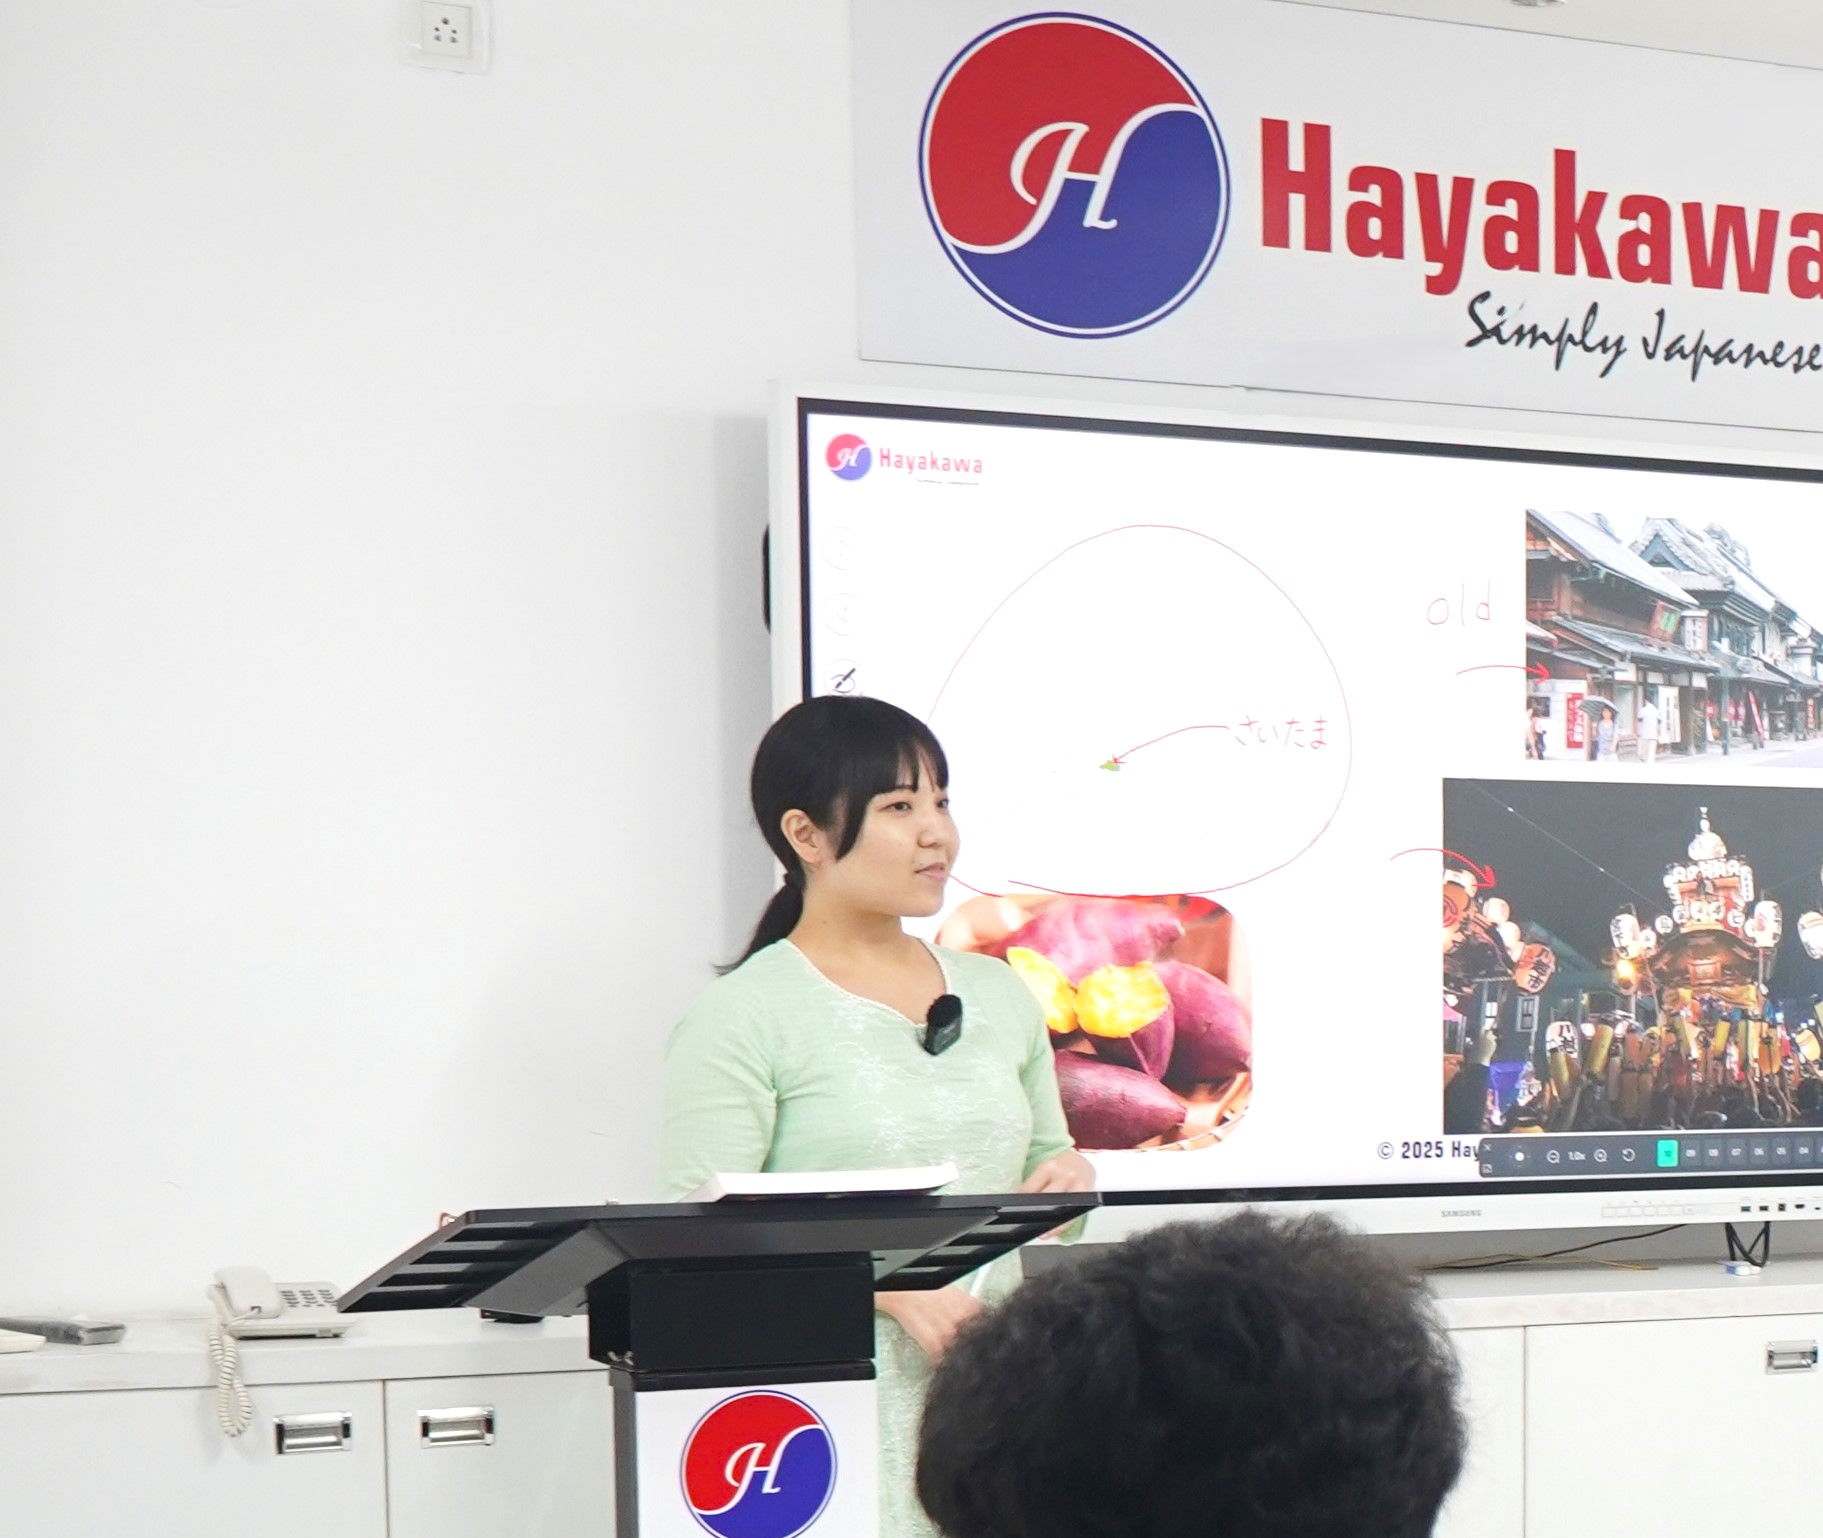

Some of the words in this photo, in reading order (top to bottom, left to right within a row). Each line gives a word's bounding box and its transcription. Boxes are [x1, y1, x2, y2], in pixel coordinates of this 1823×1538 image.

[1465, 290, 1626, 376] Simply
[879, 448, 983, 474] Hayakawa
[1427, 580, 1492, 626] old
[1235, 714, 1329, 750] さいたま
[1402, 1141, 1444, 1159] 2025
[1441, 1209, 1482, 1218] SAMSUNG
